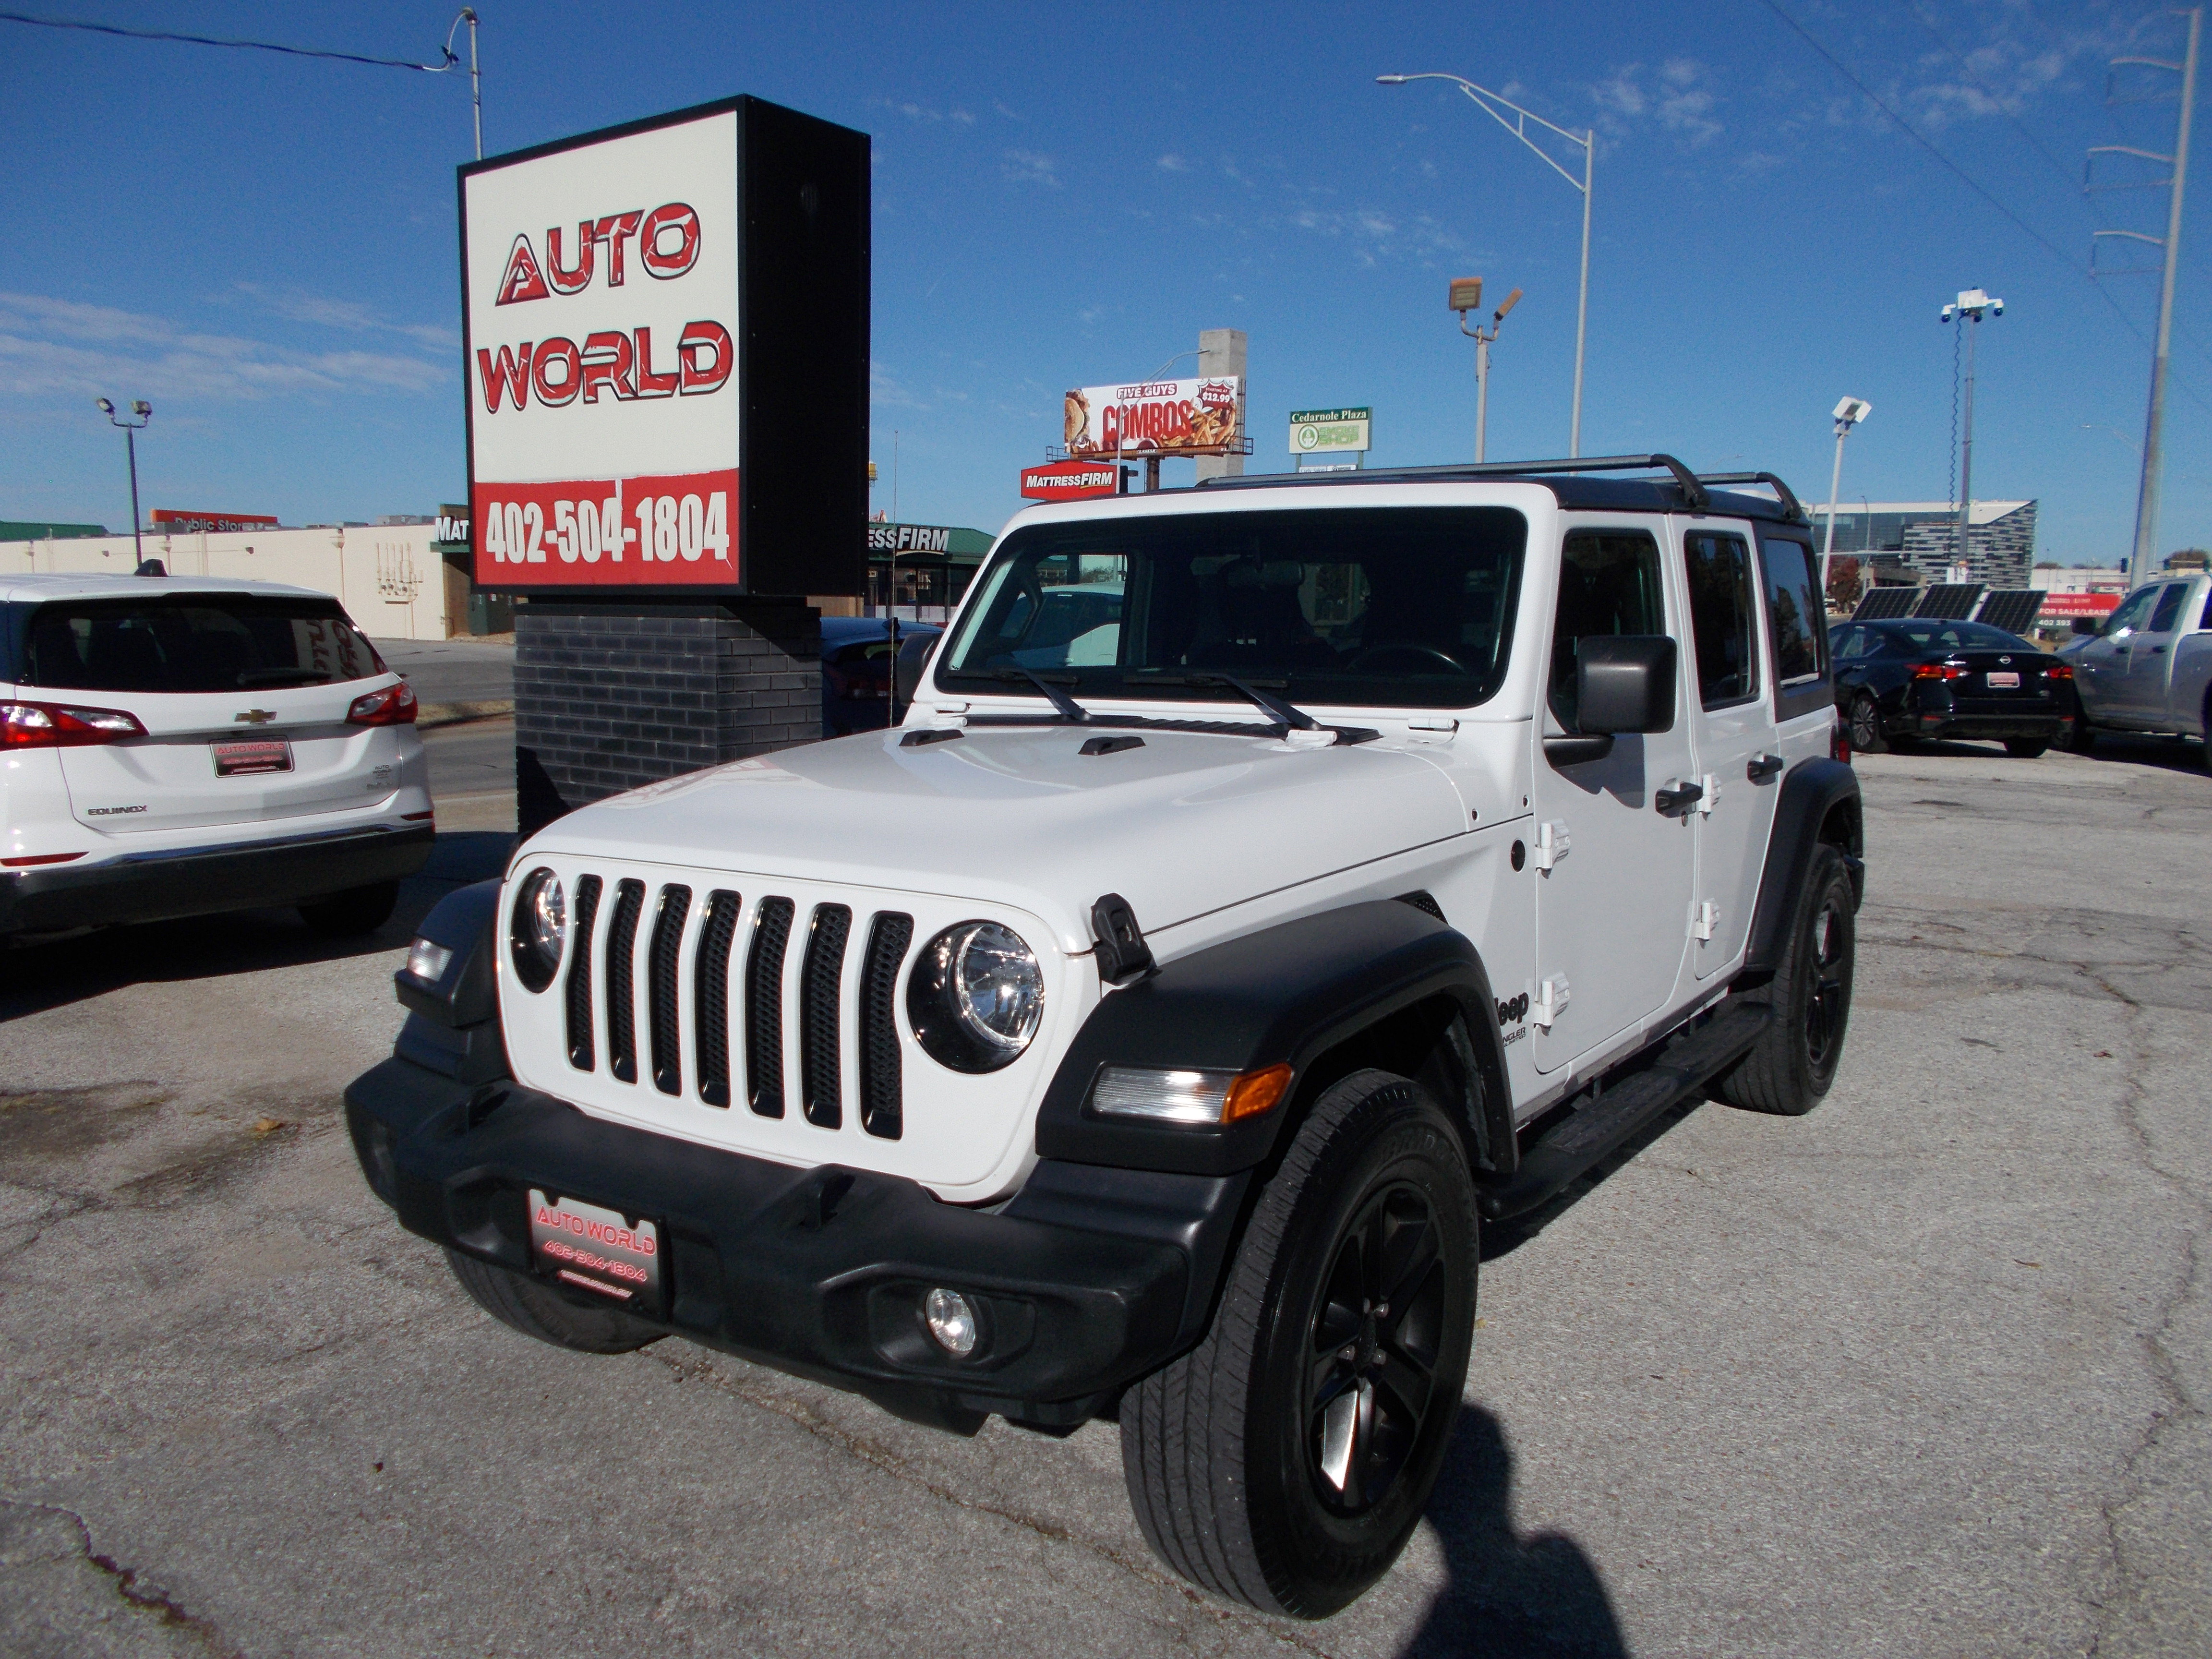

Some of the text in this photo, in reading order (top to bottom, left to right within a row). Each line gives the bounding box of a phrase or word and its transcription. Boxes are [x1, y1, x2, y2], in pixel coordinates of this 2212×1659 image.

[495, 203, 701, 306] AUTO
[477, 320, 733, 414] WORLD
[1117, 385, 1176, 398] FIVE GUYS
[1202, 391, 1230, 403] $12.99
[1102, 400, 1193, 441] COMBOS
[1292, 410, 1367, 423] Cedarnole Plaza
[1319, 425, 1360, 436] SMOKE
[1319, 433, 1359, 446] SHOP
[486, 493, 731, 564] 402-504-1804
[217, 743, 285, 755] AUTO WORLD
[87, 805, 147, 816] EQUINOX
[1503, 1026, 1526, 1043] NGLER
[536, 1205, 656, 1256] AUTO WORLD
[544, 1239, 648, 1283] 402-504-1804
